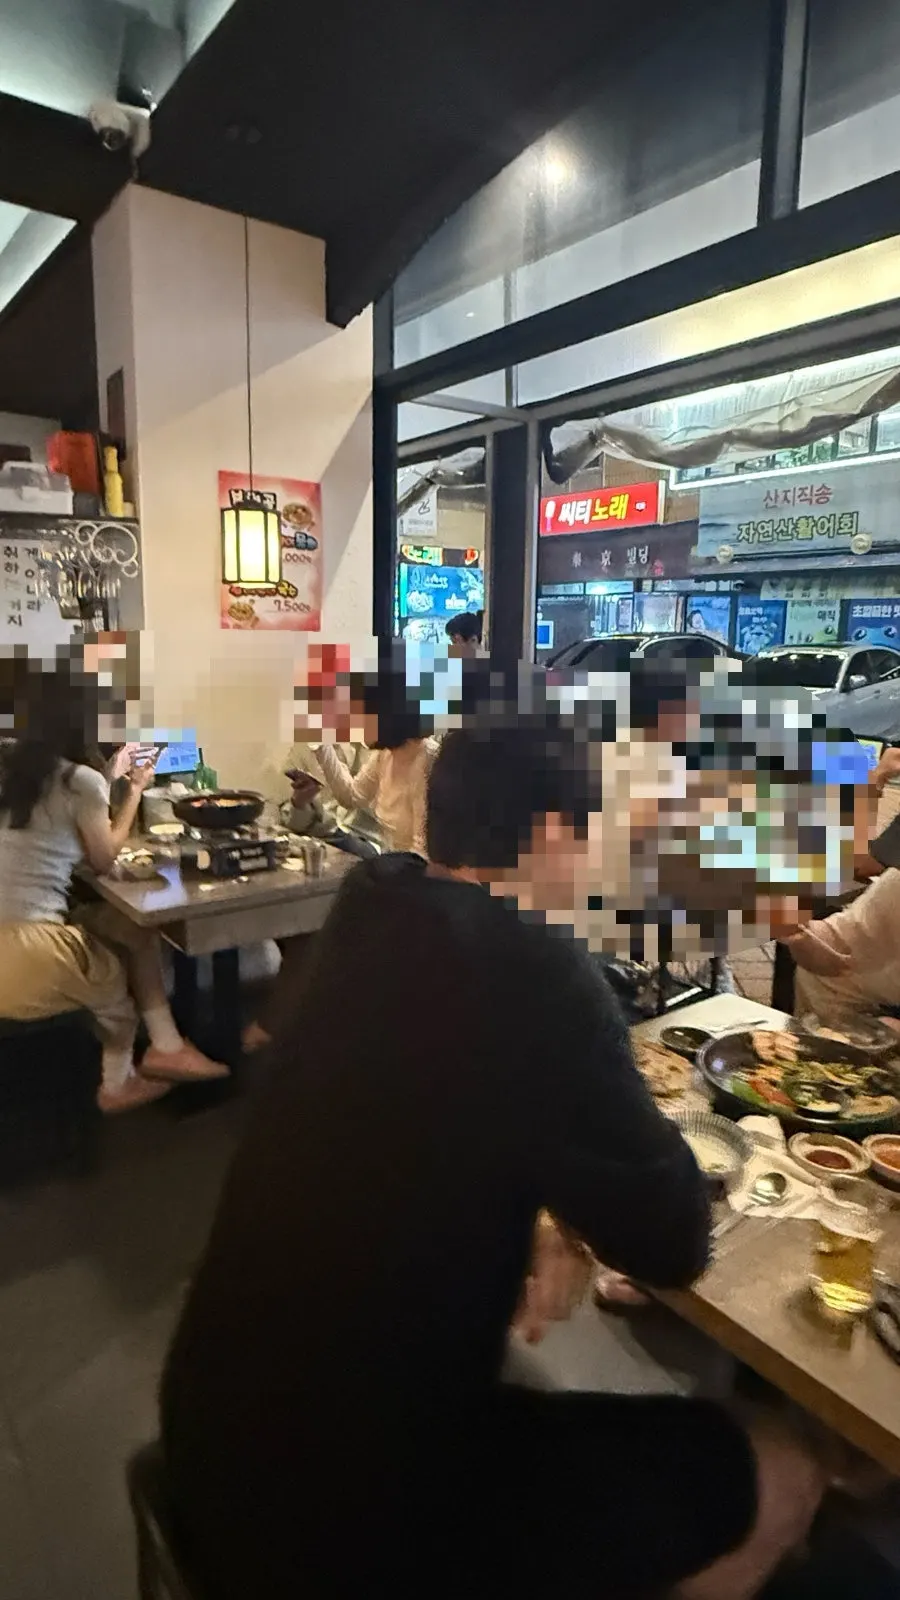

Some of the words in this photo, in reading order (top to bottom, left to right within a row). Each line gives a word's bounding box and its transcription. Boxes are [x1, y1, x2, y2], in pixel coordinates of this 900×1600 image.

[558, 493, 630, 526] 씨티노래
[763, 484, 833, 509] 산지직송
[737, 511, 859, 544] 자연산활어회
[627, 545, 649, 565] 빌딩
